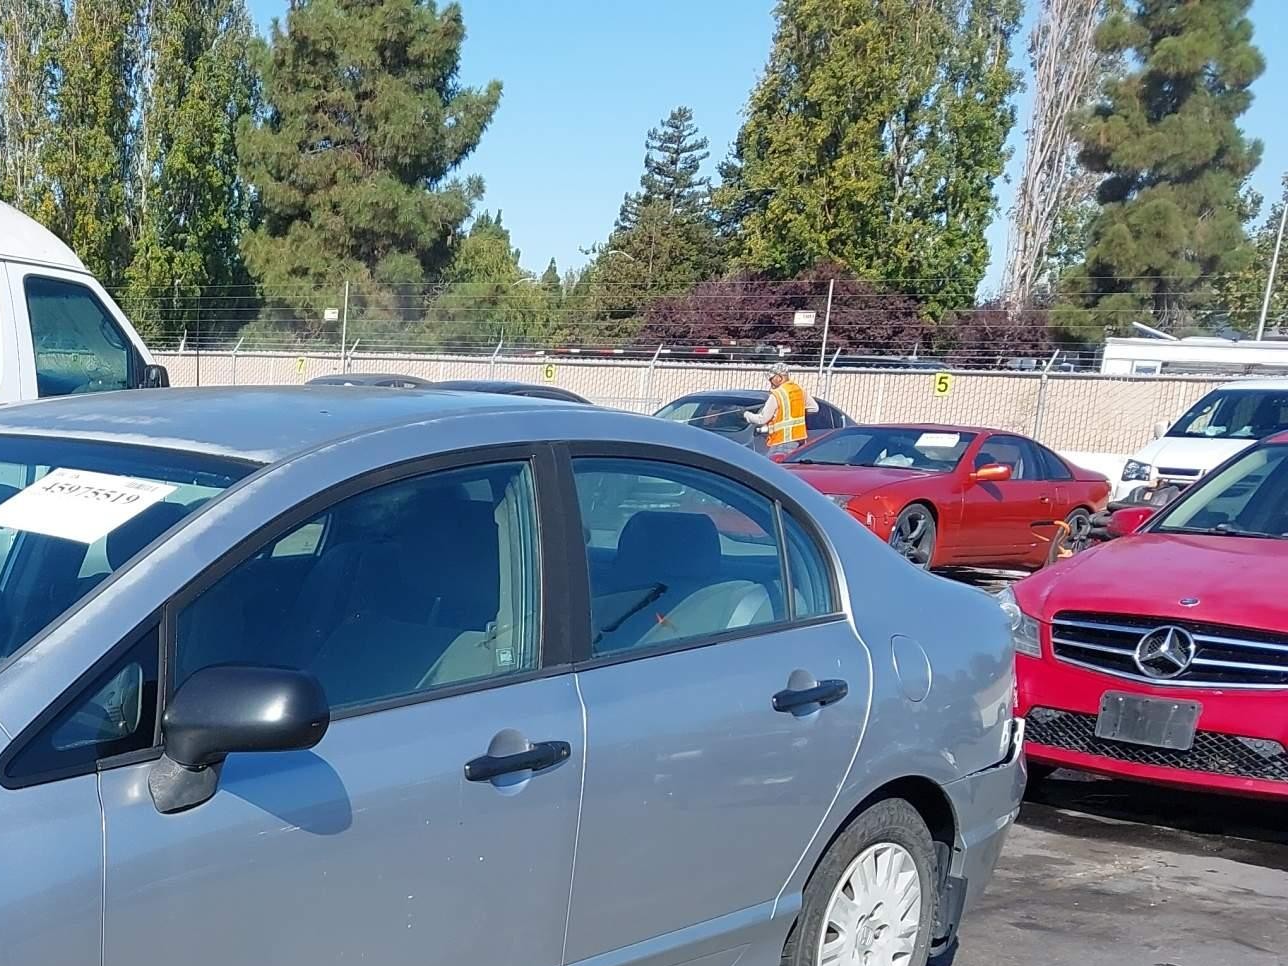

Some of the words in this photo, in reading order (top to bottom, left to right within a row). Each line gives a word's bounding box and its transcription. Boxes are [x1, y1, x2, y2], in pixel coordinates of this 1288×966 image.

[545, 364, 553, 378] 6
[937, 375, 948, 392] 5
[41, 481, 141, 505] 45975519
